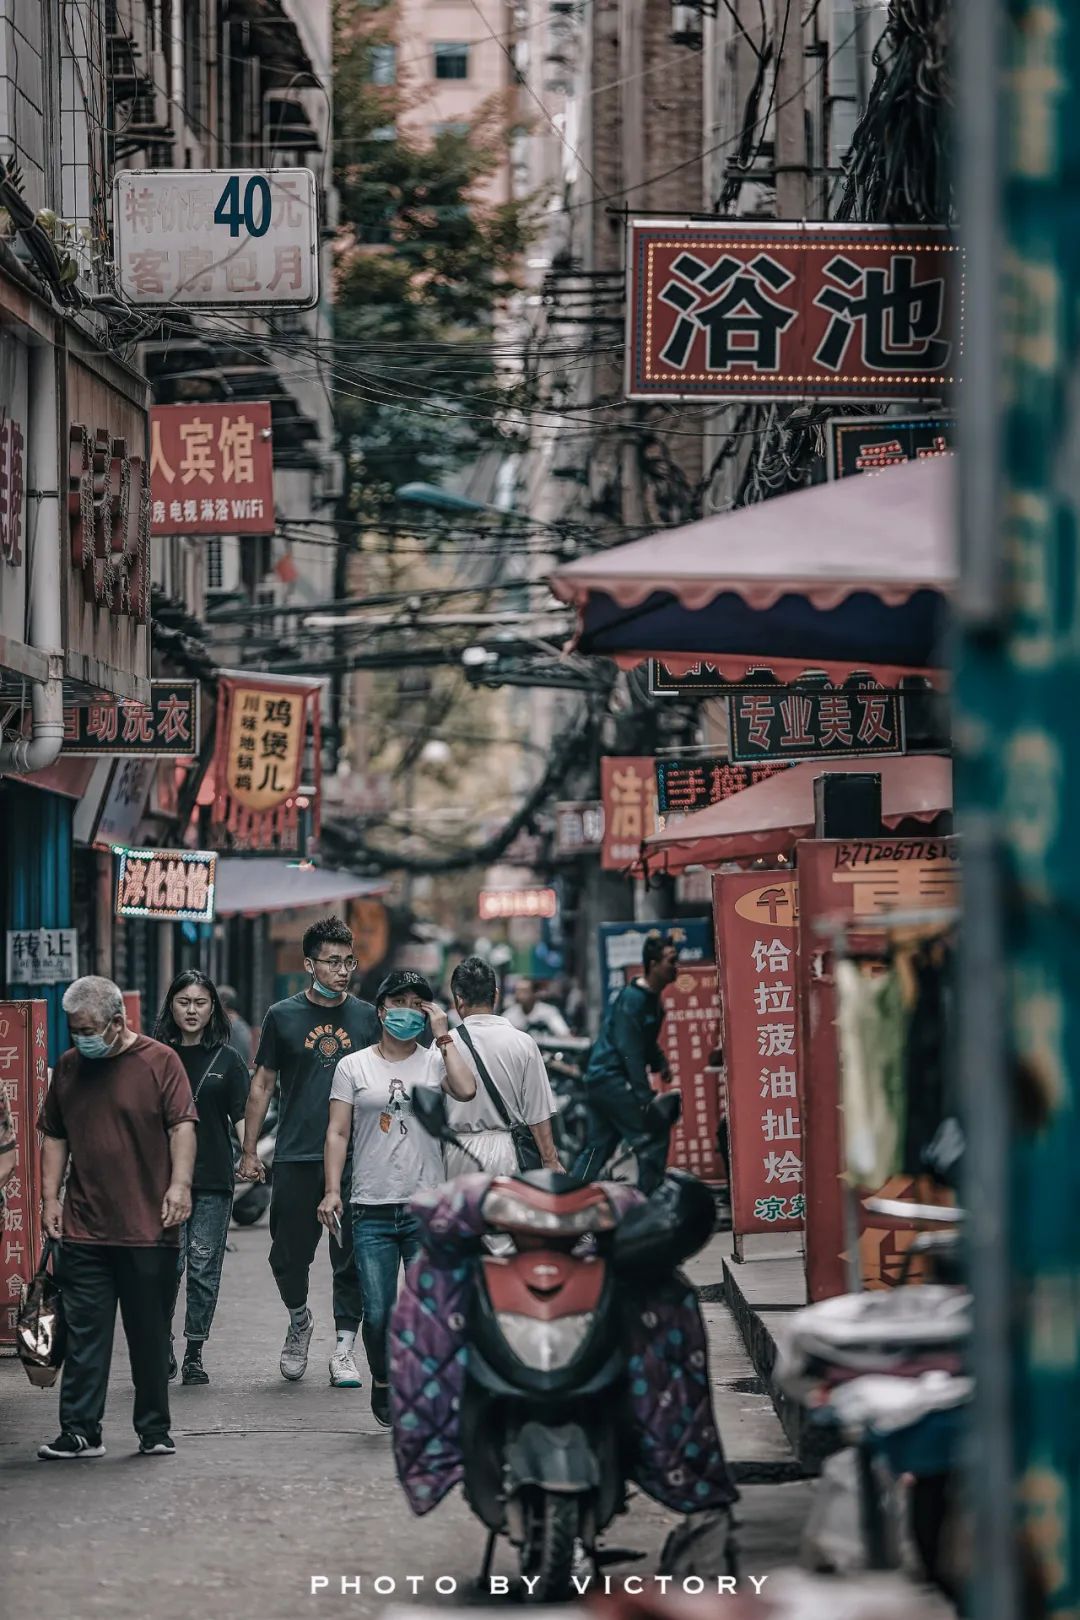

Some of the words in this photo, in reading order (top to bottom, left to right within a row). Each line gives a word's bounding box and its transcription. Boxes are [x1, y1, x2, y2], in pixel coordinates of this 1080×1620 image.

[127, 246, 303, 295] 客房包月
[658, 252, 950, 371] 浴池
[231, 500, 263, 519] WiFi
[257, 697, 292, 792] 鸡煲儿
[740, 681, 892, 750] 专业美发
[12, 932, 72, 959] 转让
